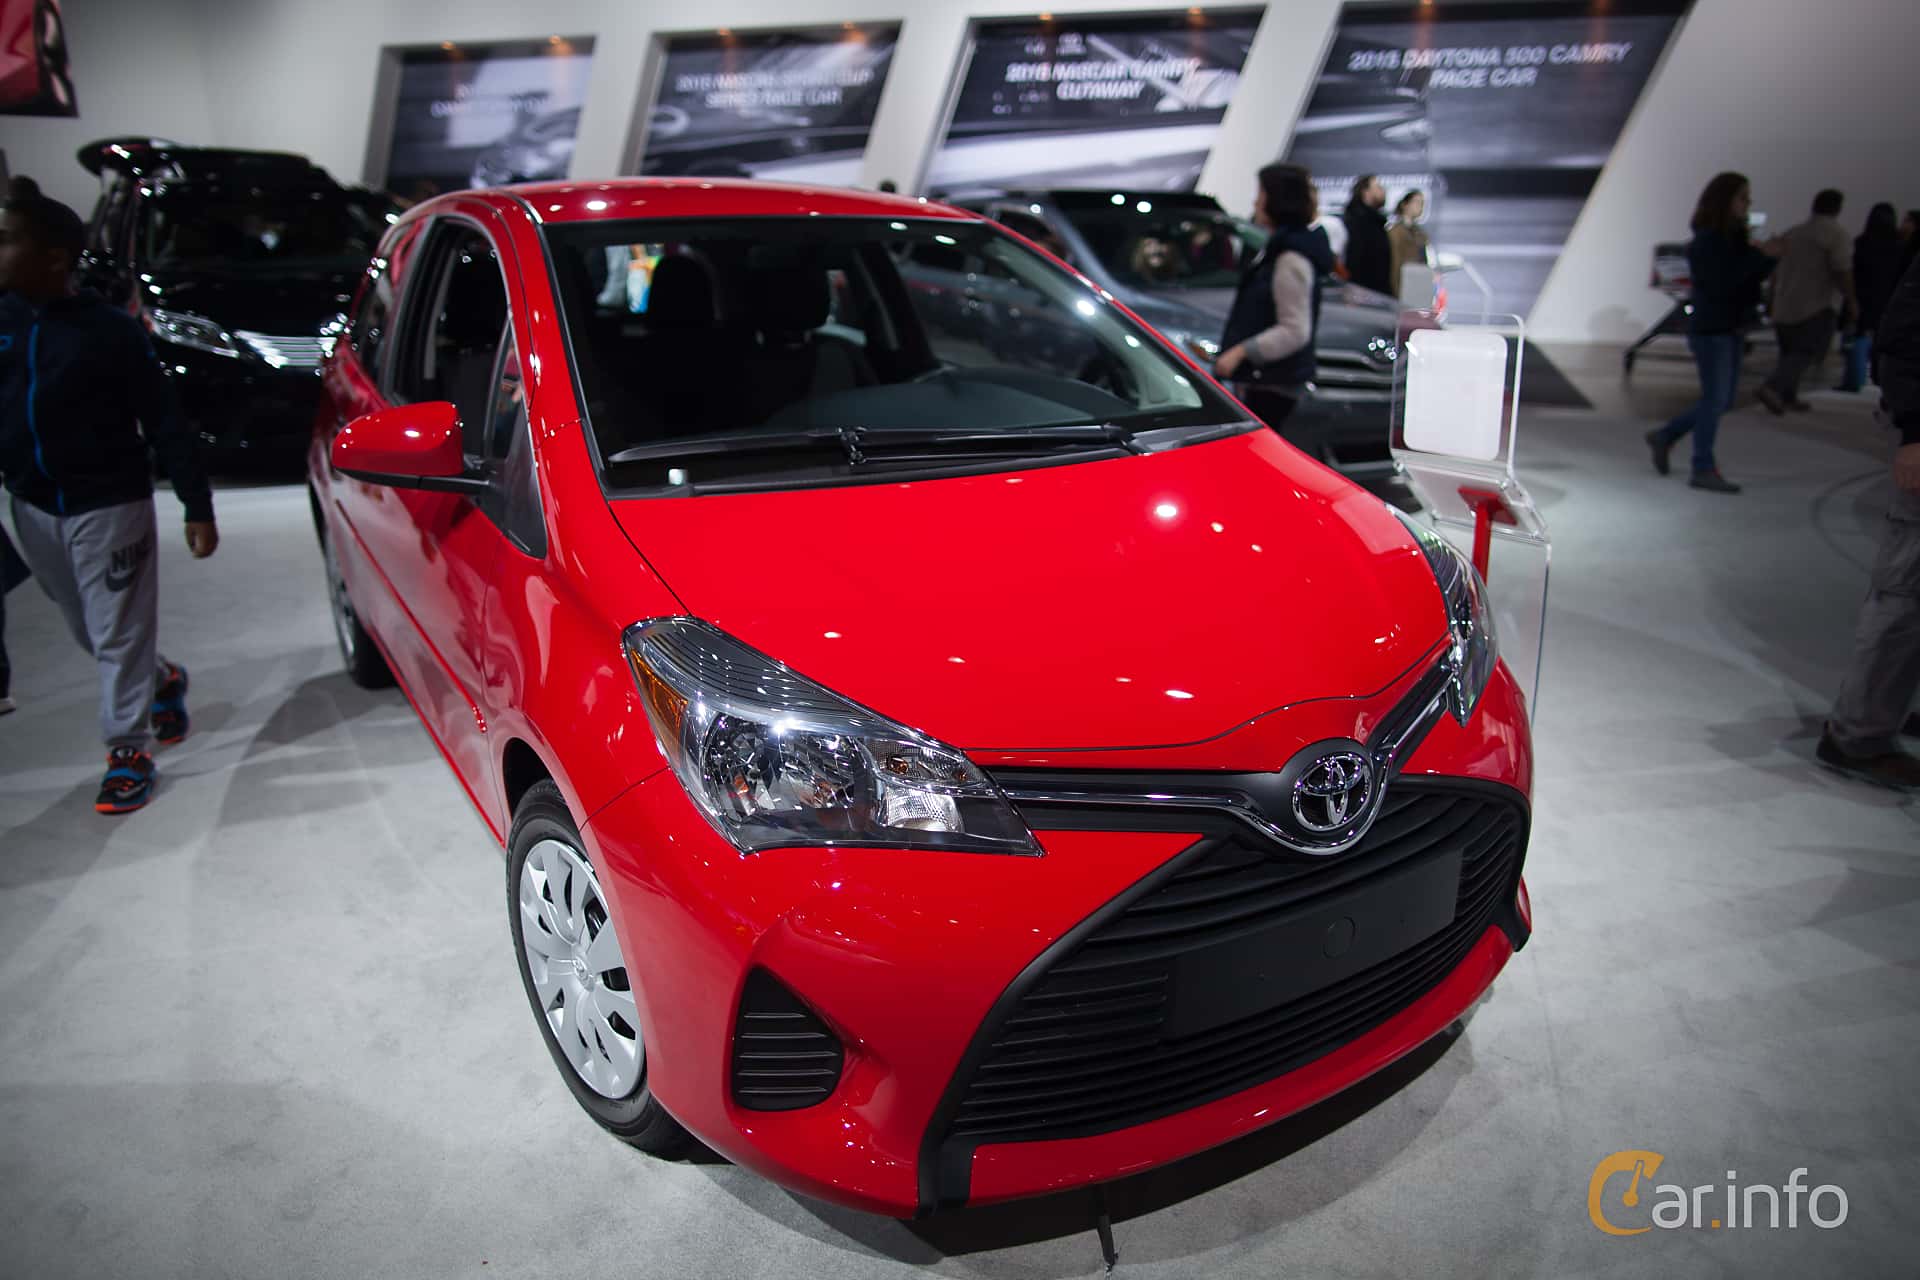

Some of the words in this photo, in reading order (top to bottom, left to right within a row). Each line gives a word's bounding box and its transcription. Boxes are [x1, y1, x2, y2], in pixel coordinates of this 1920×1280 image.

[1402, 47, 1501, 68] DAYTONA
[1504, 46, 1546, 65] 500
[1549, 42, 1634, 63] CAMRY
[1490, 67, 1538, 86] CAR
[1056, 81, 1146, 99] CUTAWAY
